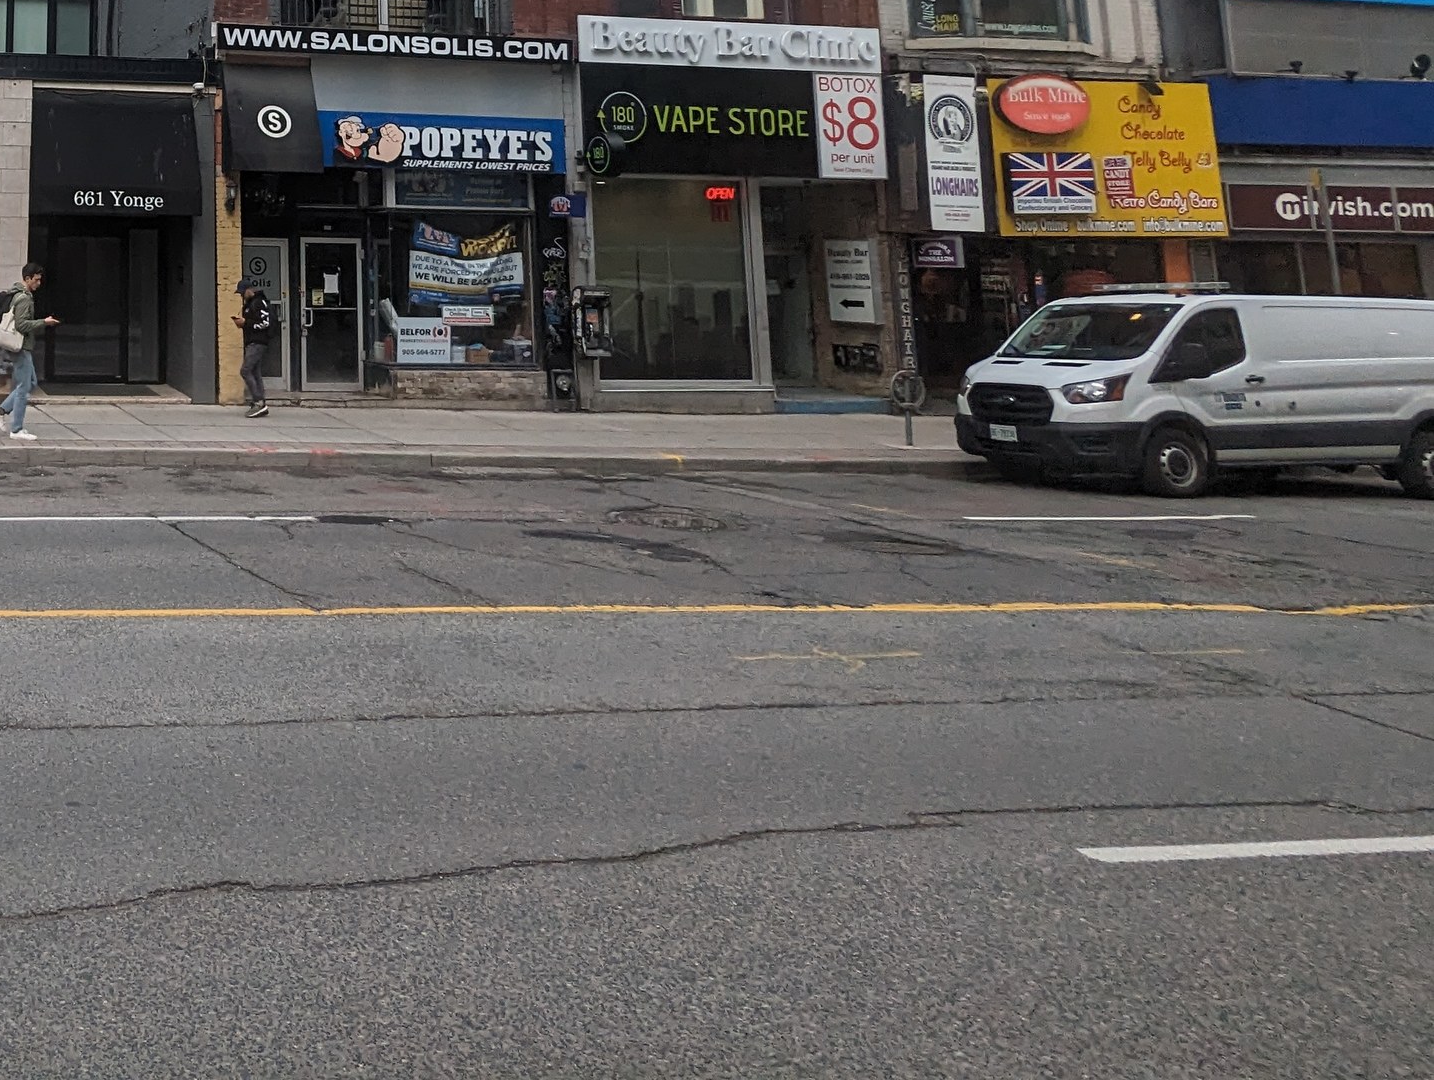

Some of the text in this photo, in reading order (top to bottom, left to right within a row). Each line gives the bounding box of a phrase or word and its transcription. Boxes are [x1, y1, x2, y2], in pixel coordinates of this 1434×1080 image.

[223, 27, 568, 61] WWW.SALONSOLIS.COM
[591, 21, 876, 64] Beauty Bar Clinic
[818, 76, 877, 94] BOTOX
[1008, 86, 1087, 103] Bulk Mine
[1118, 95, 1162, 120] Candy
[653, 105, 810, 137] VAPE STORE
[822, 96, 880, 151] $8
[1121, 122, 1186, 140] Chocolate
[402, 126, 553, 160] POPEYE'S
[402, 158, 551, 172] SUPPLEMENTS LOWEST PRICES
[831, 153, 875, 164] per unit
[1159, 151, 1192, 174] Belly
[1104, 169, 1130, 179] CANDY
[706, 187, 735, 200] OPEN
[931, 176, 979, 197] LONGHAIRS
[73, 190, 164, 210] 661 Yonge
[1148, 189, 1189, 215] Candy
[1189, 189, 1218, 209] Bars
[1015, 219, 1038, 235] Shop
[415, 255, 430, 263] DUE
[432, 257, 442, 266] TO
[415, 272, 431, 281] WE
[432, 273, 456, 285] WILL
[457, 277, 470, 286] BE
[423, 265, 439, 273] ARE
[441, 267, 471, 276] FORCED
[400, 328, 431, 336] BELFOR
